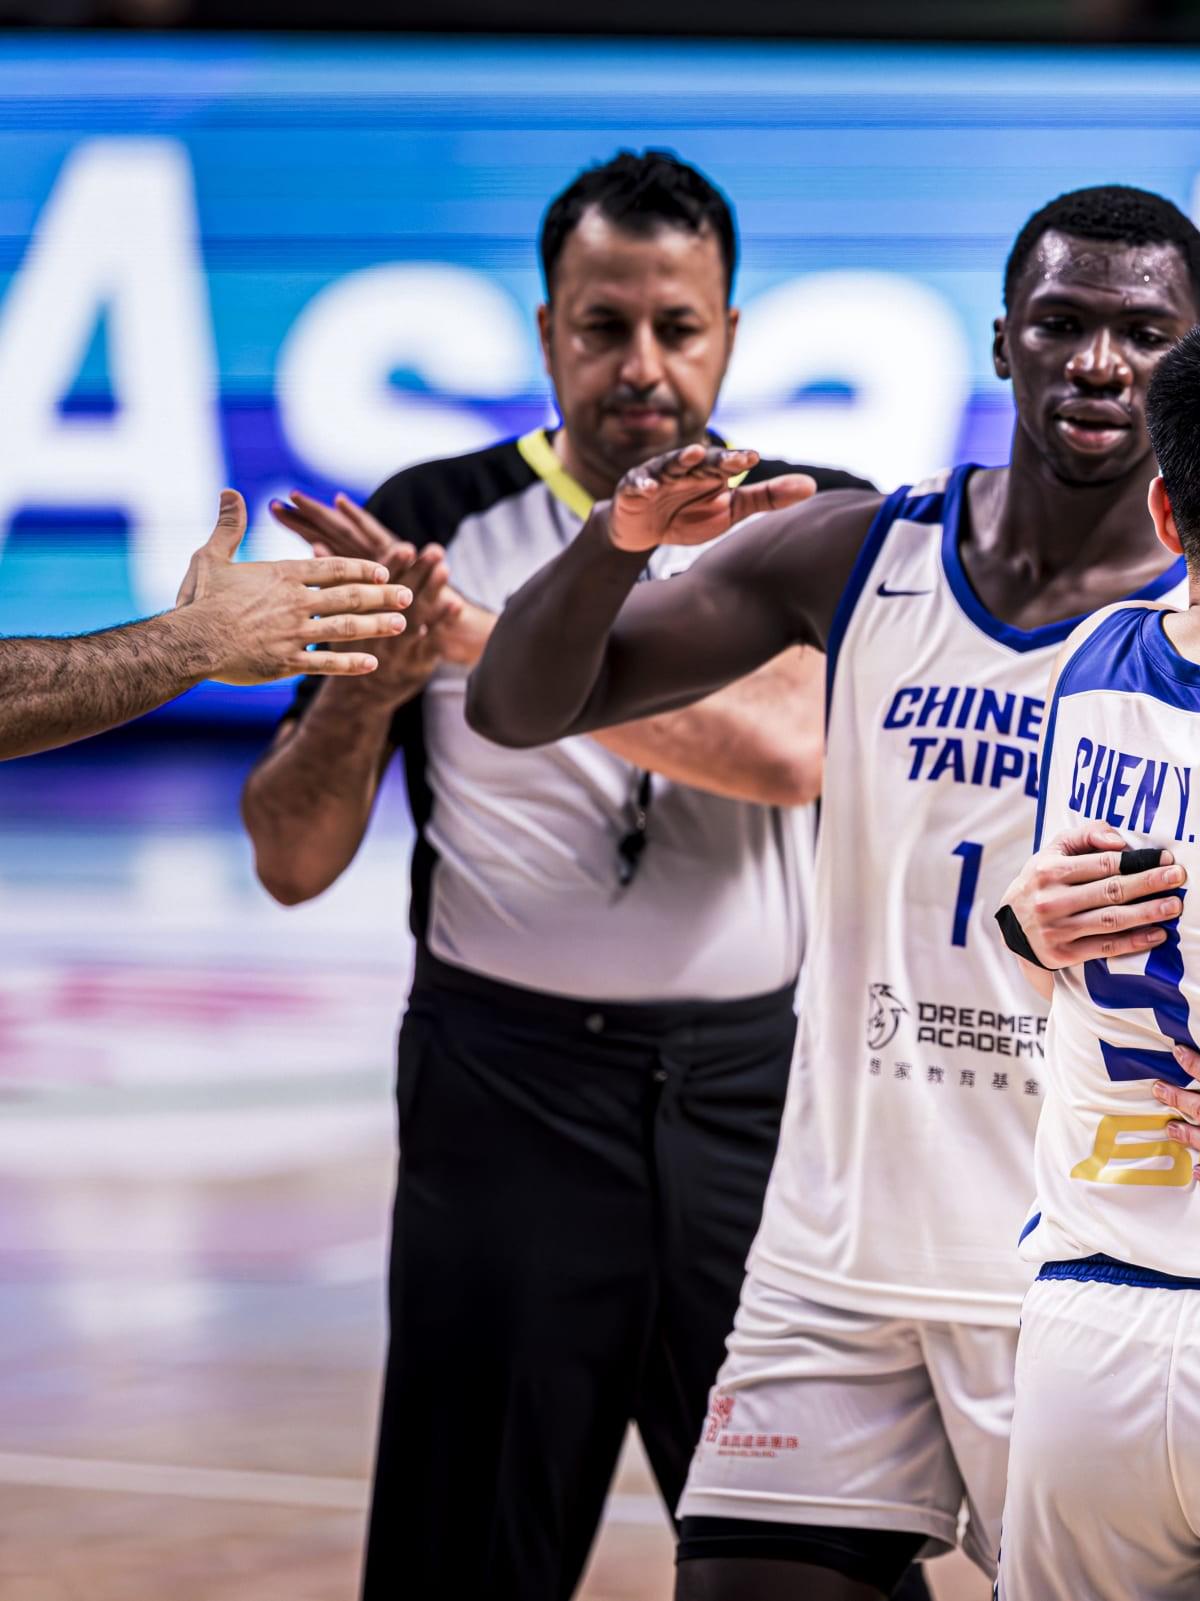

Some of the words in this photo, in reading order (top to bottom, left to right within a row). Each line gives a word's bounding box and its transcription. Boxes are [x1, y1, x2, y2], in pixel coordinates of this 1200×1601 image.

[0, 137, 975, 620] Asa
[1069, 736, 1168, 835] CHEN
[951, 841, 983, 948] 1
